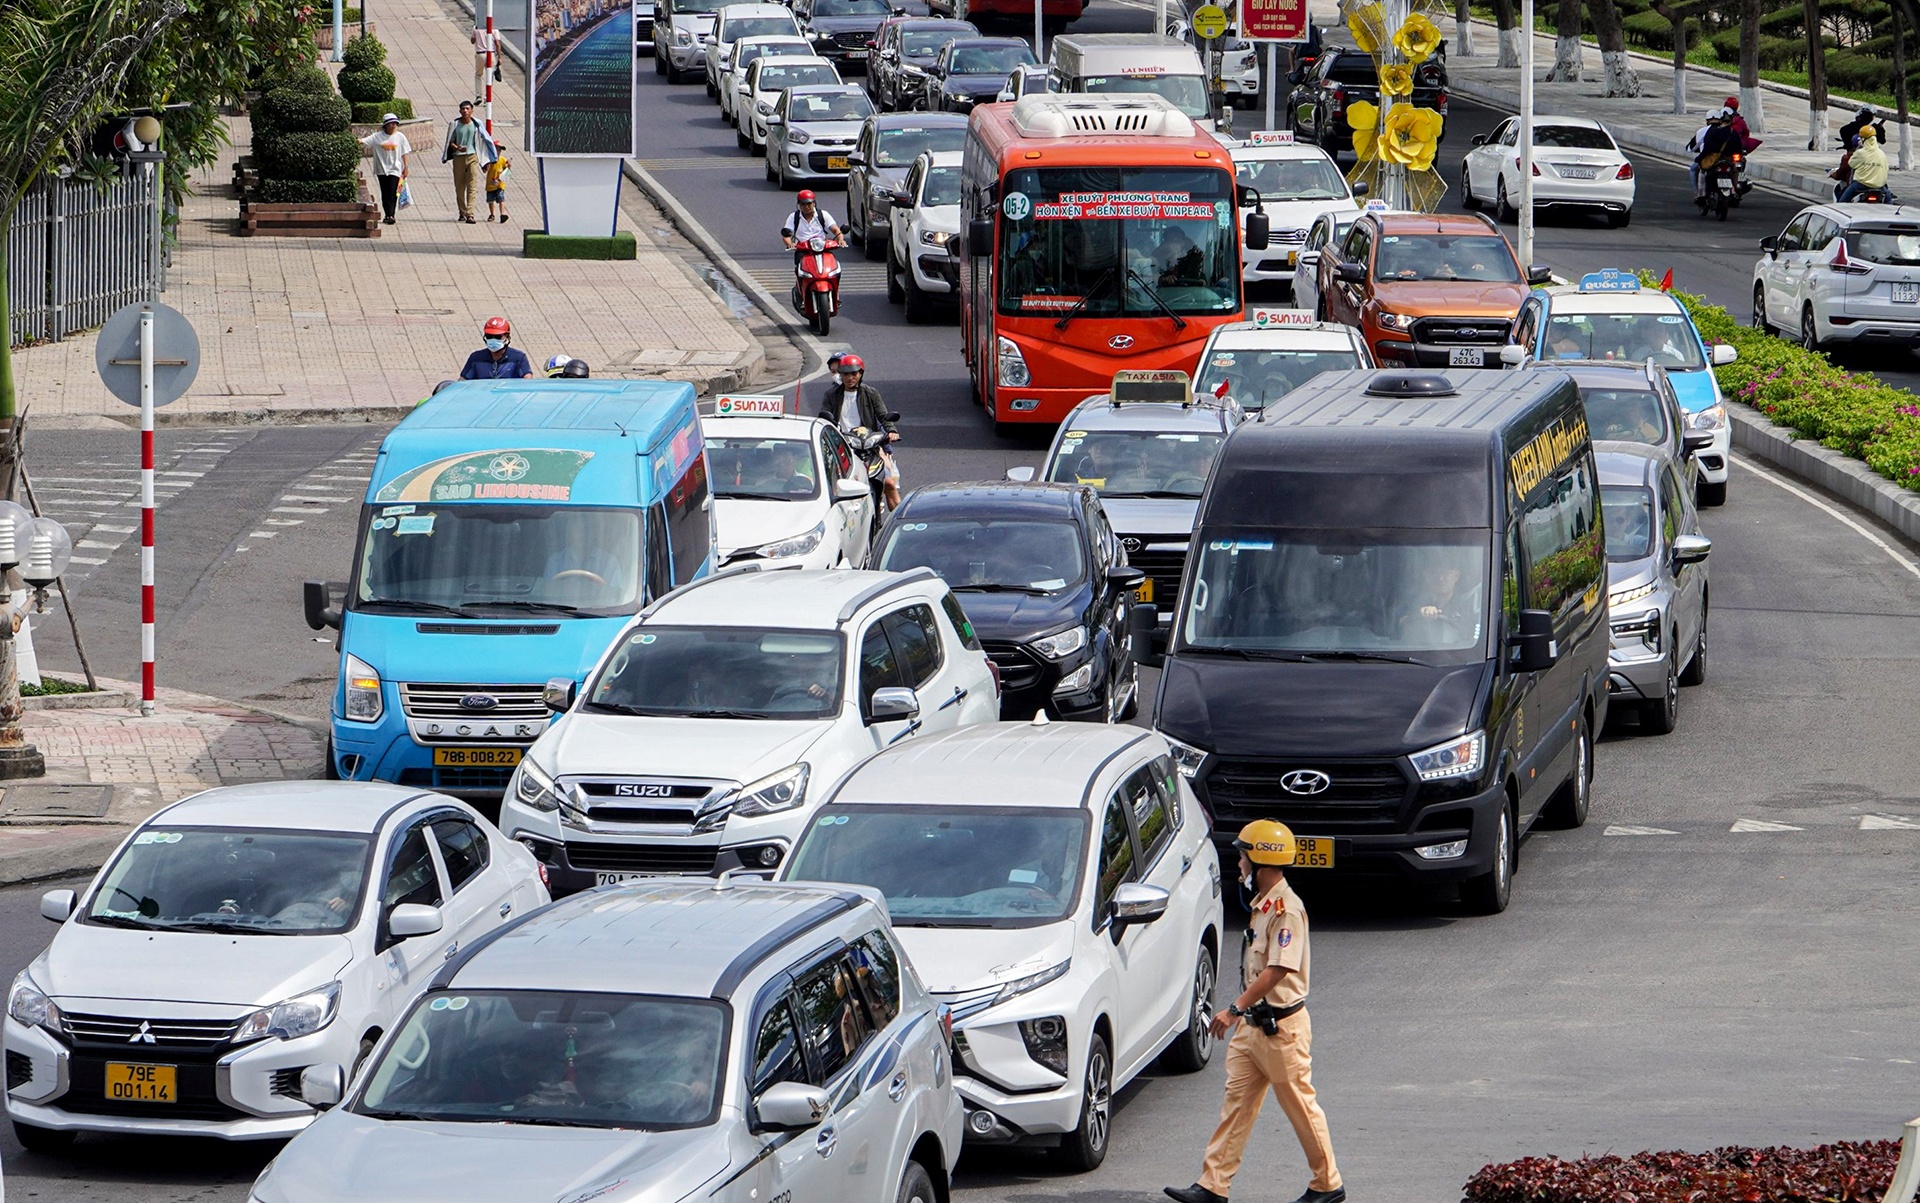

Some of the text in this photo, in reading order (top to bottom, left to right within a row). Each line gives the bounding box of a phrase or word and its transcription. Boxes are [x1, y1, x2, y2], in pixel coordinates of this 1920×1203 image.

[1062, 192, 1188, 203] XE BUÝT PHƯƠNG TRANG
[1005, 198, 1026, 214] 05-2
[1036, 204, 1058, 216] HÒN
[1118, 206, 1133, 216] XE
[1134, 203, 1160, 216] BUÝT
[1163, 206, 1212, 217] VINPEARL
[1585, 280, 1636, 289] QUỐC TẾ
[1292, 314, 1311, 324] TAXI
[1460, 348, 1474, 356] 47C
[1453, 356, 1480, 364] 263.43
[758, 401, 780, 412] TAXI
[1512, 442, 1540, 502] QUEEN
[436, 484, 570, 500] SAO LIMOUSINE
[468, 696, 488, 706] Ford
[442, 750, 514, 762] 78B-008.22
[615, 784, 672, 796] ISUZU
[1256, 842, 1285, 852] CSGT
[1294, 854, 1326, 866] 3.65
[126, 1066, 156, 1082] 79E
[114, 1082, 168, 1100] 001.14
